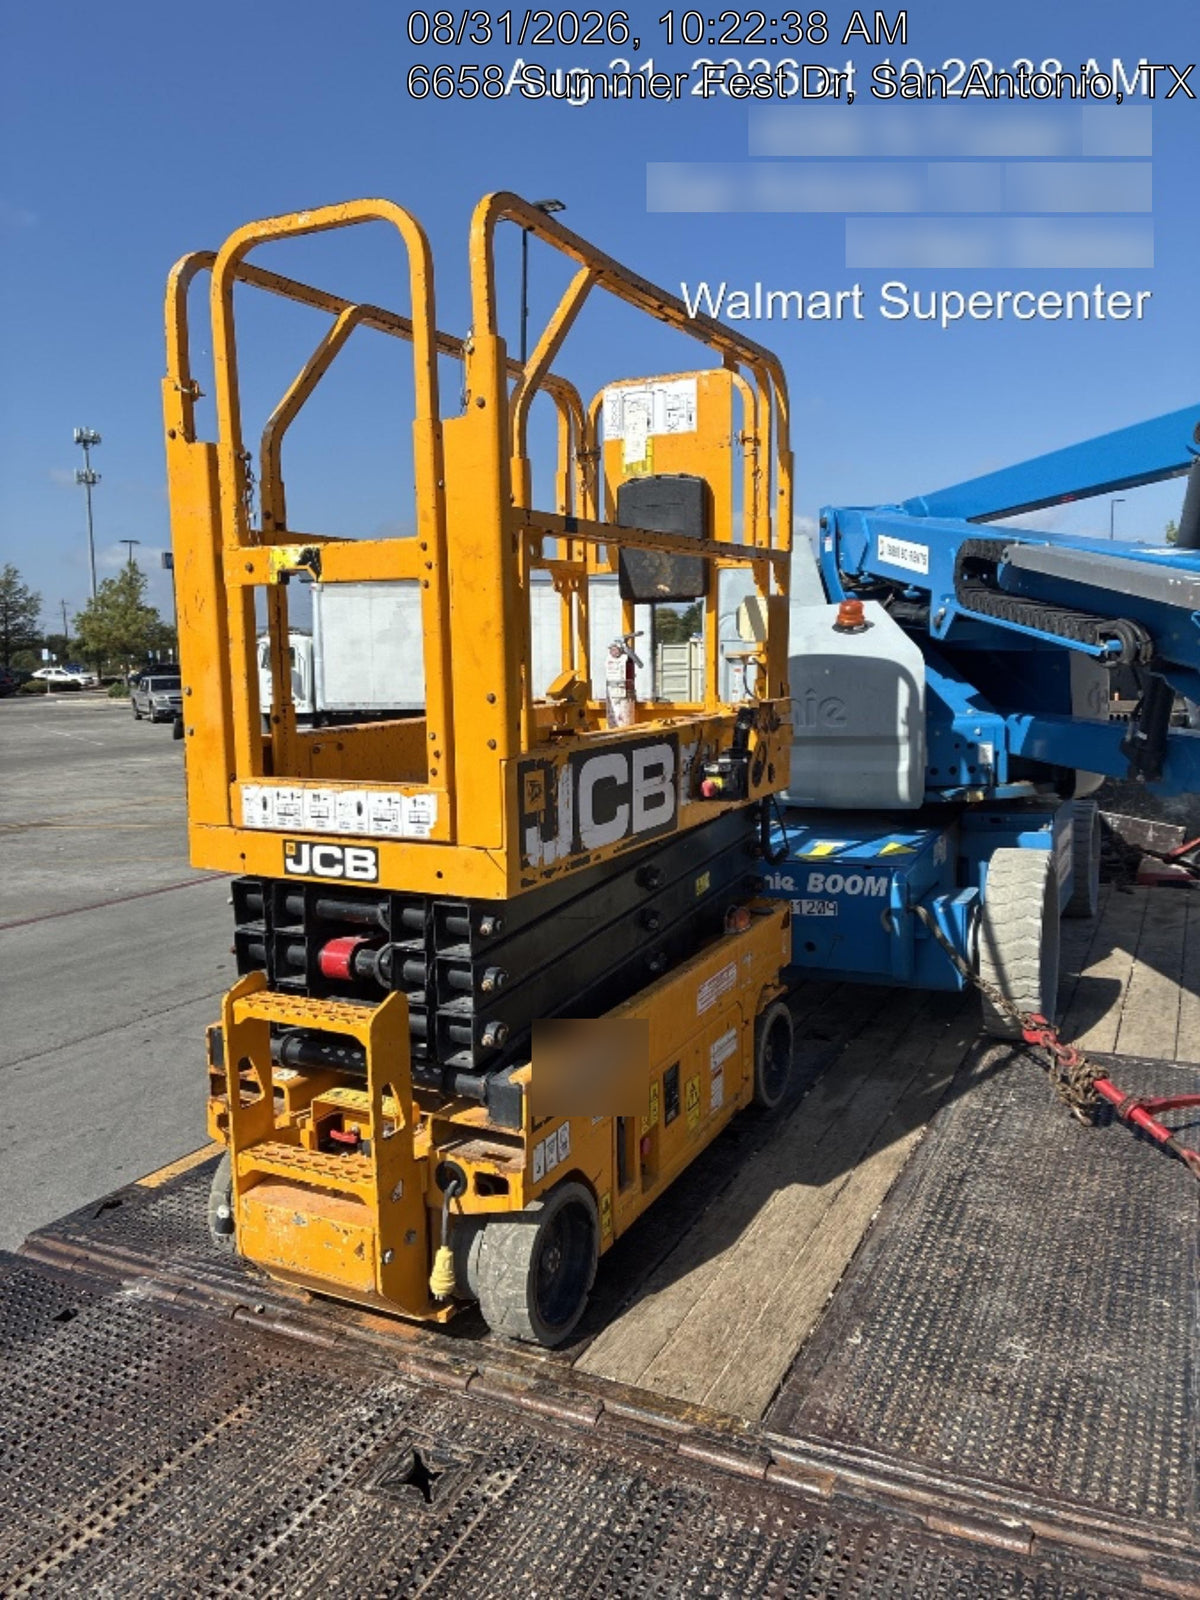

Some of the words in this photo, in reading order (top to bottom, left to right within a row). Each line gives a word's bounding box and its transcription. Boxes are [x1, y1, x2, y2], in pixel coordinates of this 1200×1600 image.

[525, 743, 675, 868] JCB
[285, 843, 378, 881] JCB
[807, 872, 889, 897] BOOM
